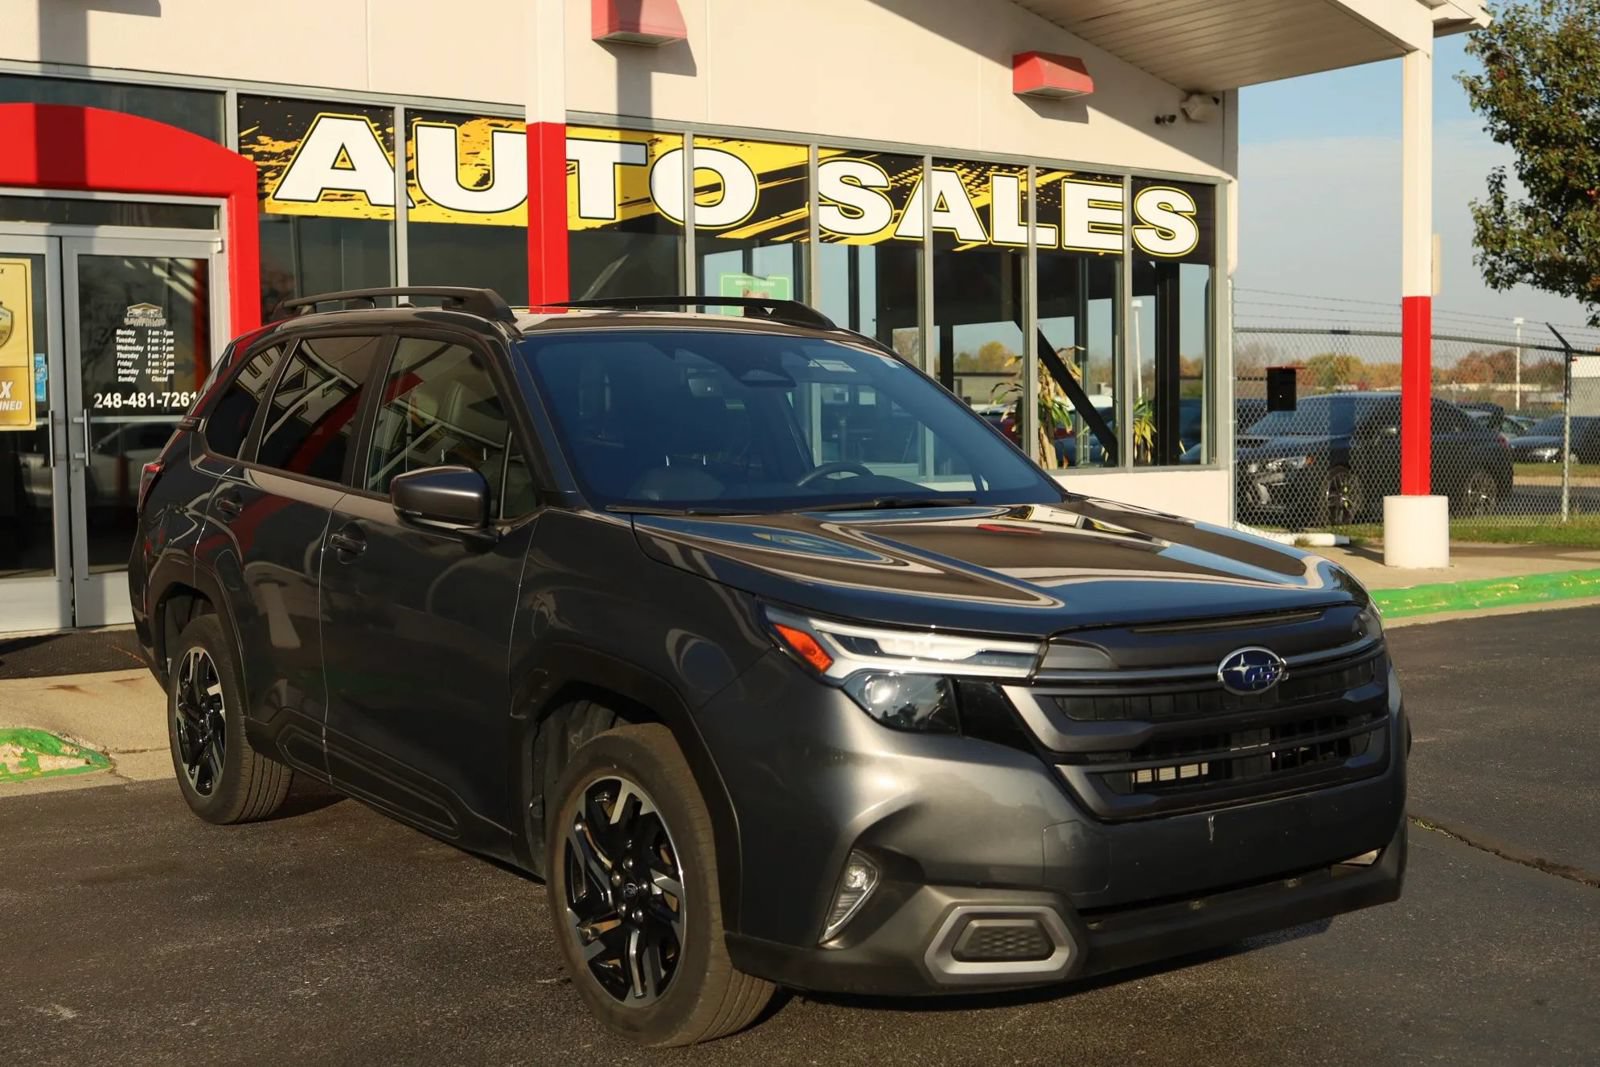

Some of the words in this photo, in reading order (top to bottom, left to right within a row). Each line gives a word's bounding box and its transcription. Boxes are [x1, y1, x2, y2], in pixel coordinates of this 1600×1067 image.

[273, 111, 760, 228] AUTO
[816, 156, 1199, 257] SALES
[116, 329, 136, 337] Monday
[116, 344, 144, 352] Wednesday
[116, 352, 139, 360] Thursday
[117, 360, 133, 368] Friday
[118, 368, 139, 376] Saturday
